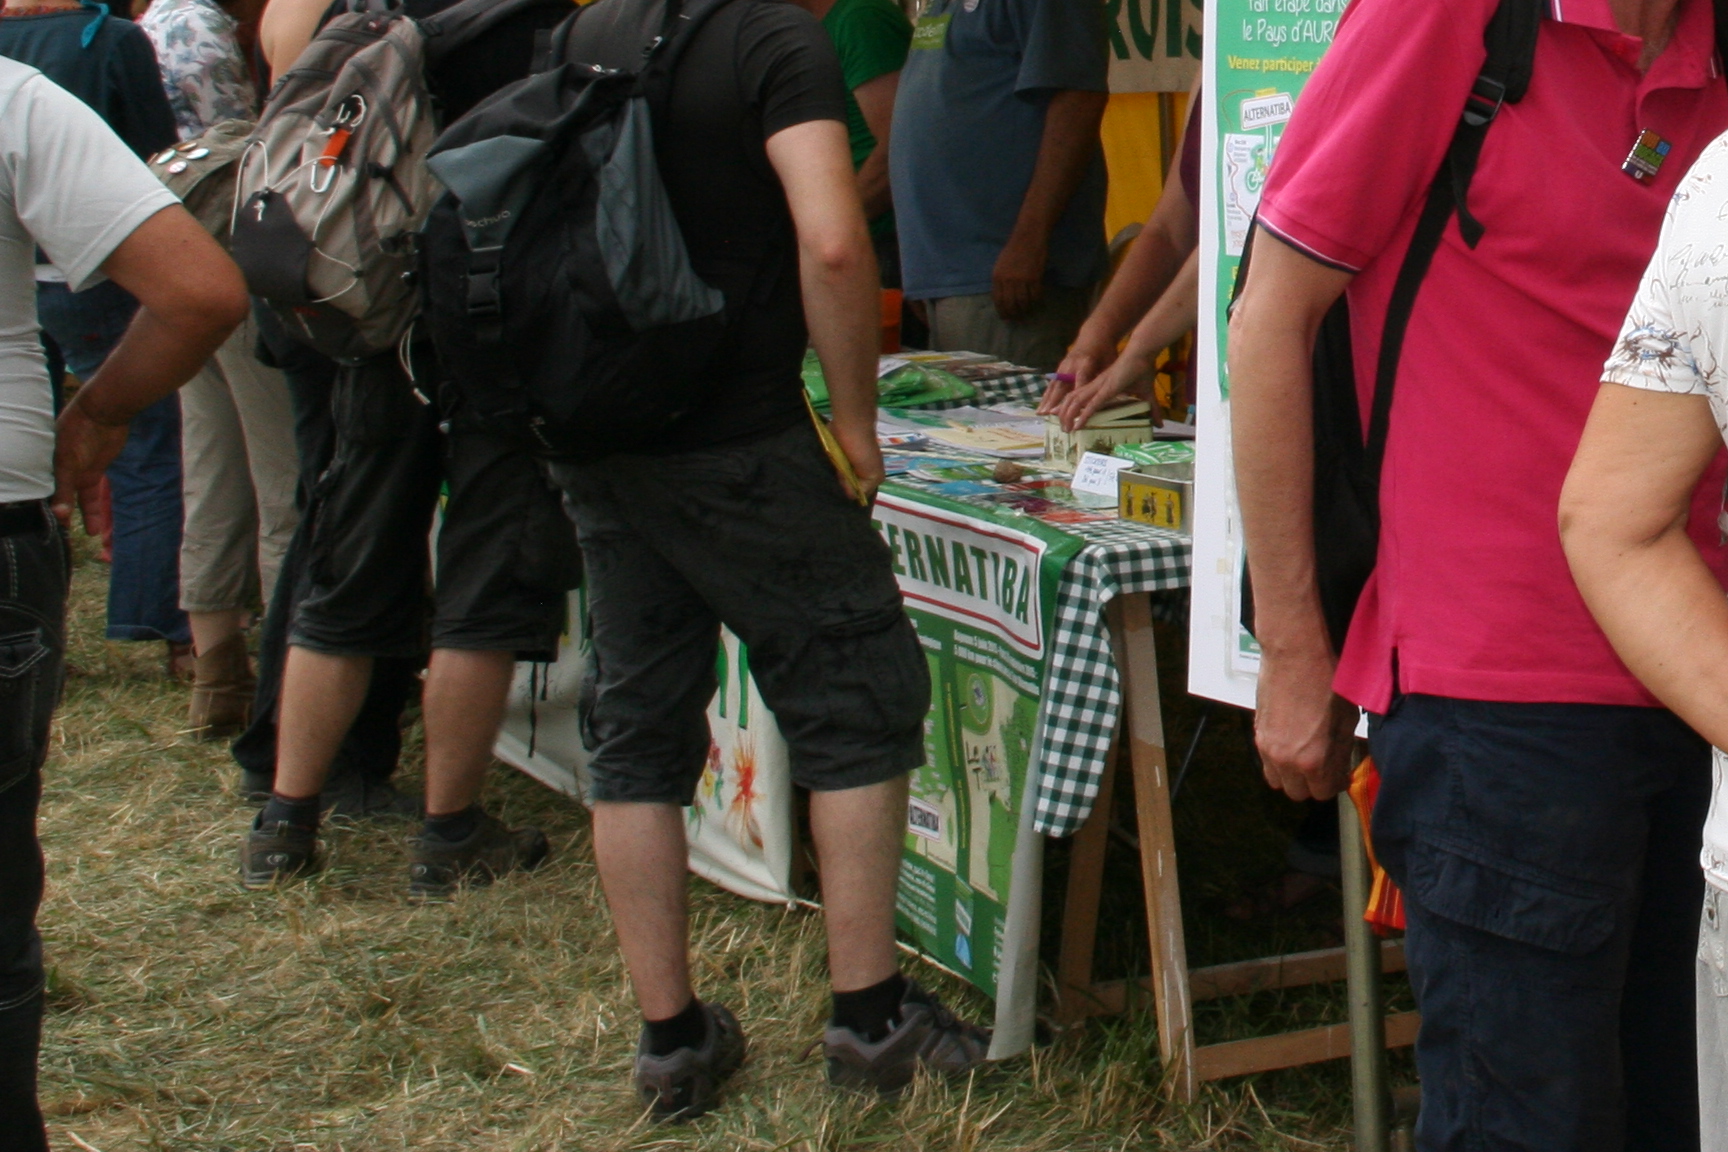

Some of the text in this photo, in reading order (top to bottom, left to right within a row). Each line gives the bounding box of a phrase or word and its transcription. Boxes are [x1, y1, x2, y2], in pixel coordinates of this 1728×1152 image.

[1242, 18, 1253, 42] le
[1256, 18, 1288, 48] Pays
[1227, 55, 1314, 75] Venez participer
[1243, 101, 1292, 122] ALTERNATIBA
[871, 517, 1031, 626] ERNATIBA
